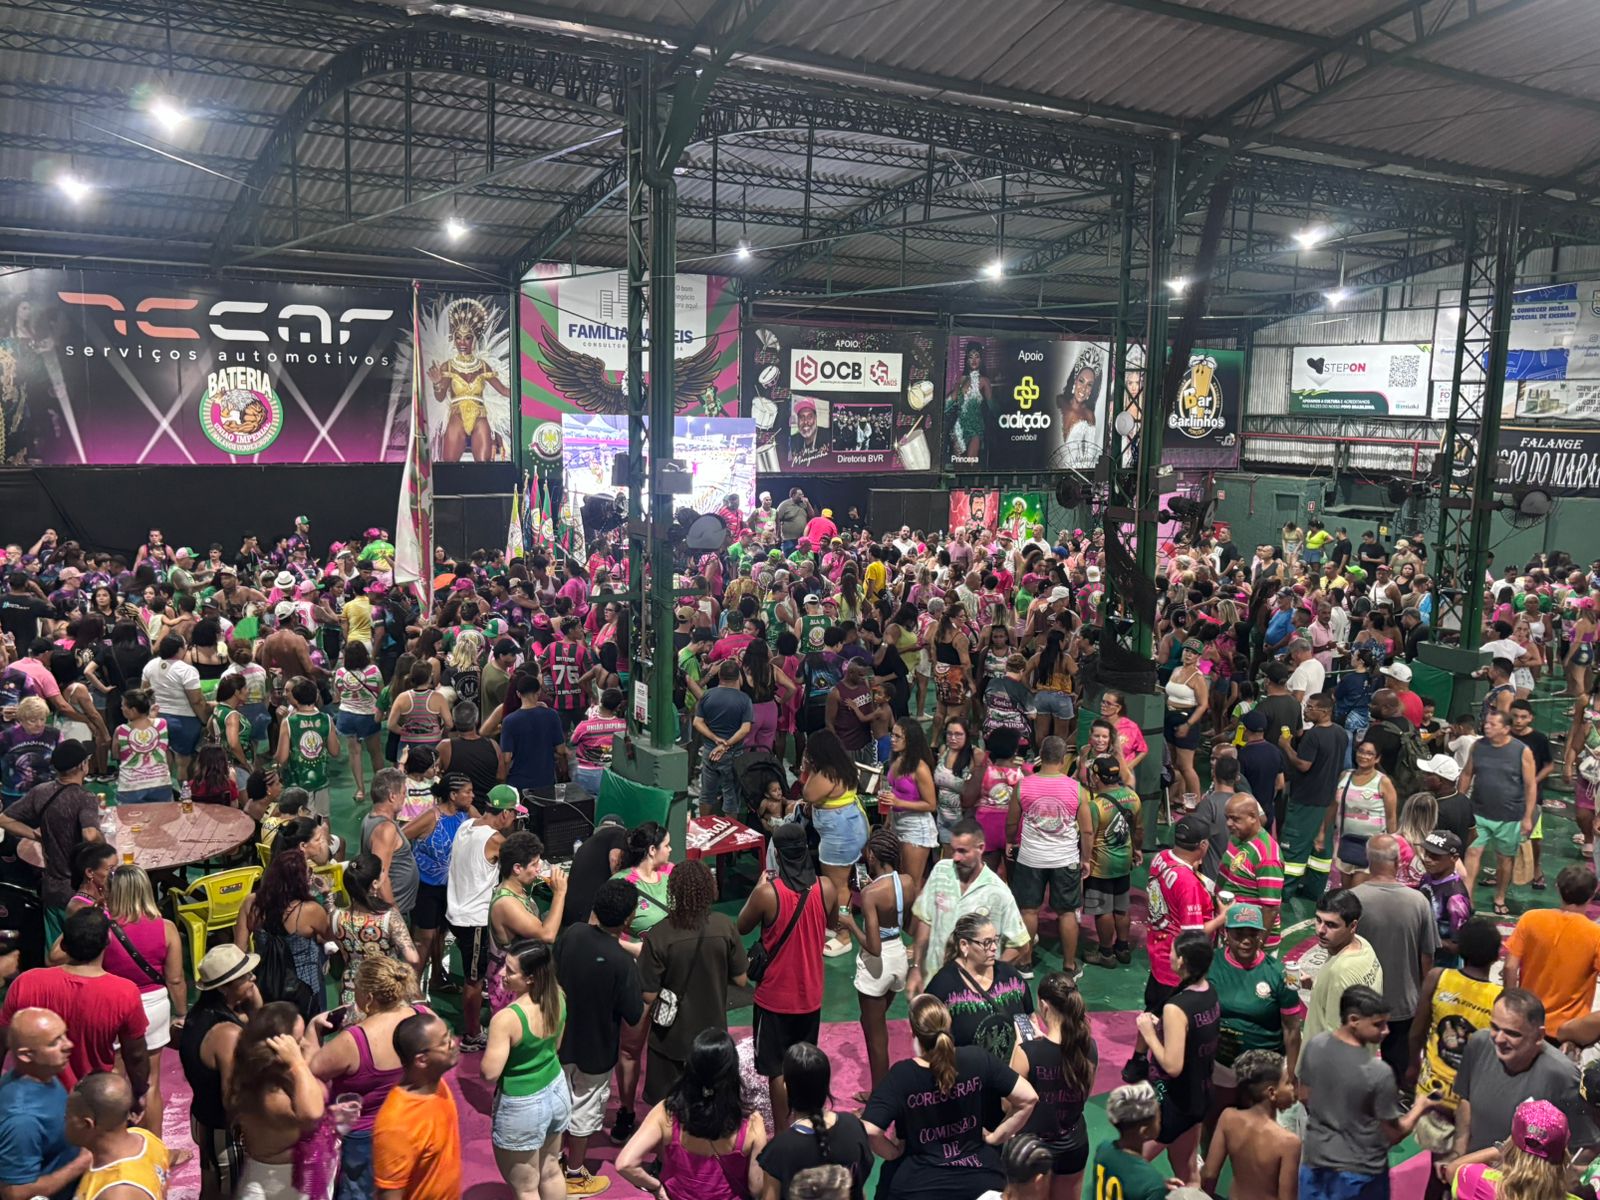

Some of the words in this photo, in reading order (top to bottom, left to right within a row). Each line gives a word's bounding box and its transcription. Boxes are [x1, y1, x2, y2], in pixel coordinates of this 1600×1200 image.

[568, 322, 628, 341] FAMÍLIA
[66, 344, 197, 363] serviços
[218, 350, 390, 367] automotivos
[1018, 350, 1044, 363] Apoio
[820, 361, 862, 380] OCB
[207, 366, 273, 399] BATERIA
[1183, 387, 1212, 409] Bar
[998, 411, 1051, 432] adição
[1169, 414, 1225, 428] Carlinhos
[1520, 437, 1584, 450] FALANGE
[837, 454, 866, 464] Diretoria
[951, 455, 979, 463] Princesa
[1550, 452, 1600, 490] MARA
[943, 1140, 961, 1159] DE
